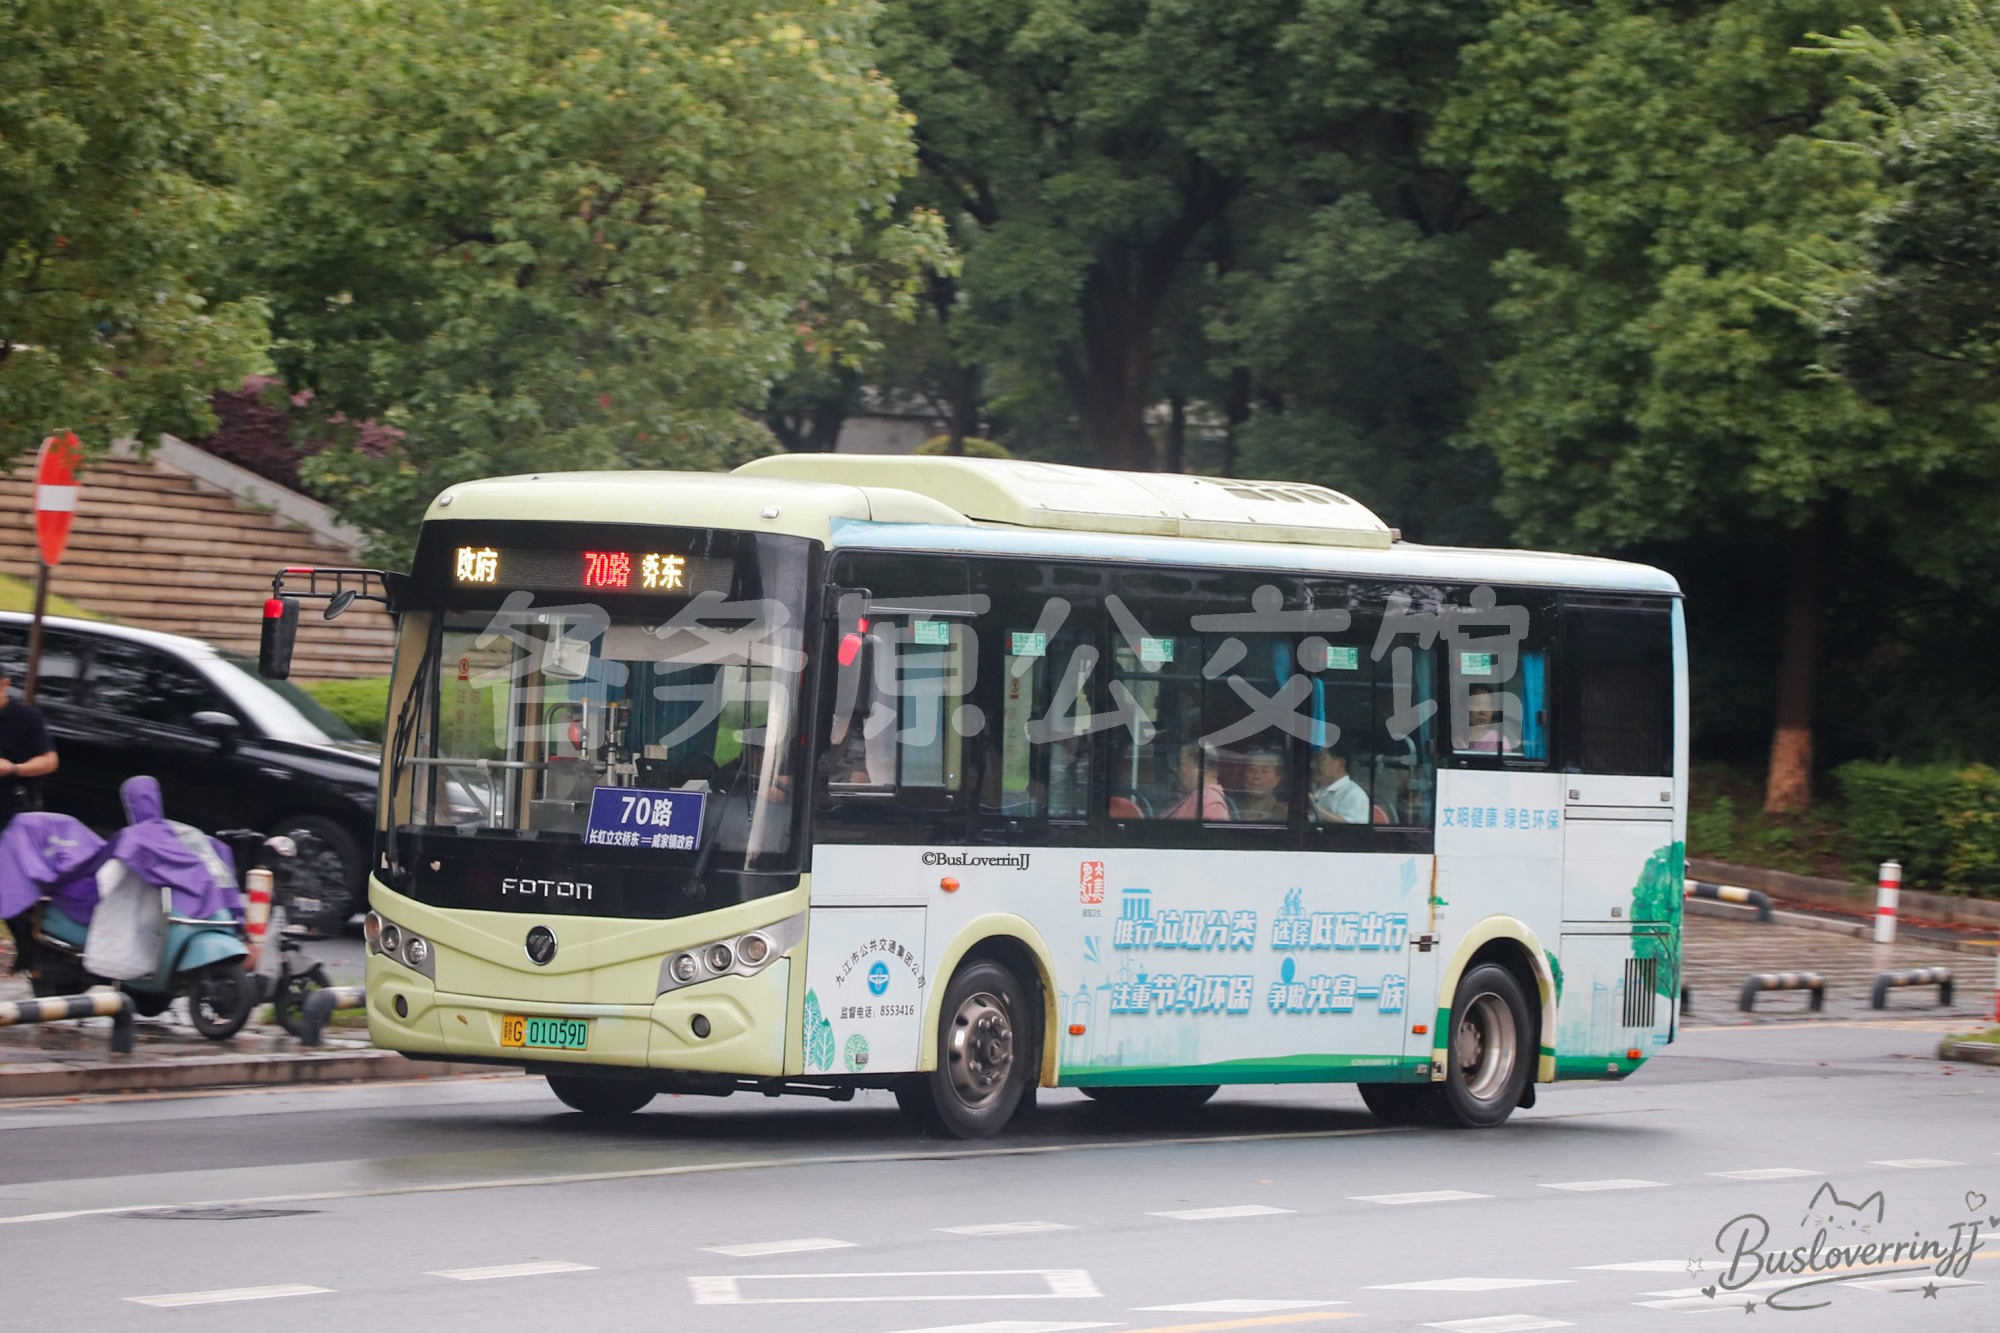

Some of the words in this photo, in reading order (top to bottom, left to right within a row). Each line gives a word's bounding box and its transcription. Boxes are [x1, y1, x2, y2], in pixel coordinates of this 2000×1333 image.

[585, 552, 631, 587] 70路
[621, 796, 673, 827] 70路
[1442, 806, 1498, 828] 文明健康
[1504, 807, 1560, 830] 绿色环保
[502, 878, 593, 900] FOTON
[1113, 910, 1257, 950] 推行垃圾分类
[1271, 911, 1407, 950] 选择低碳出行
[835, 938, 926, 989] 九江市公共交通集团公司
[1111, 974, 1253, 1014] 注重节约环保
[1268, 974, 1405, 1014] 争做光盘一族
